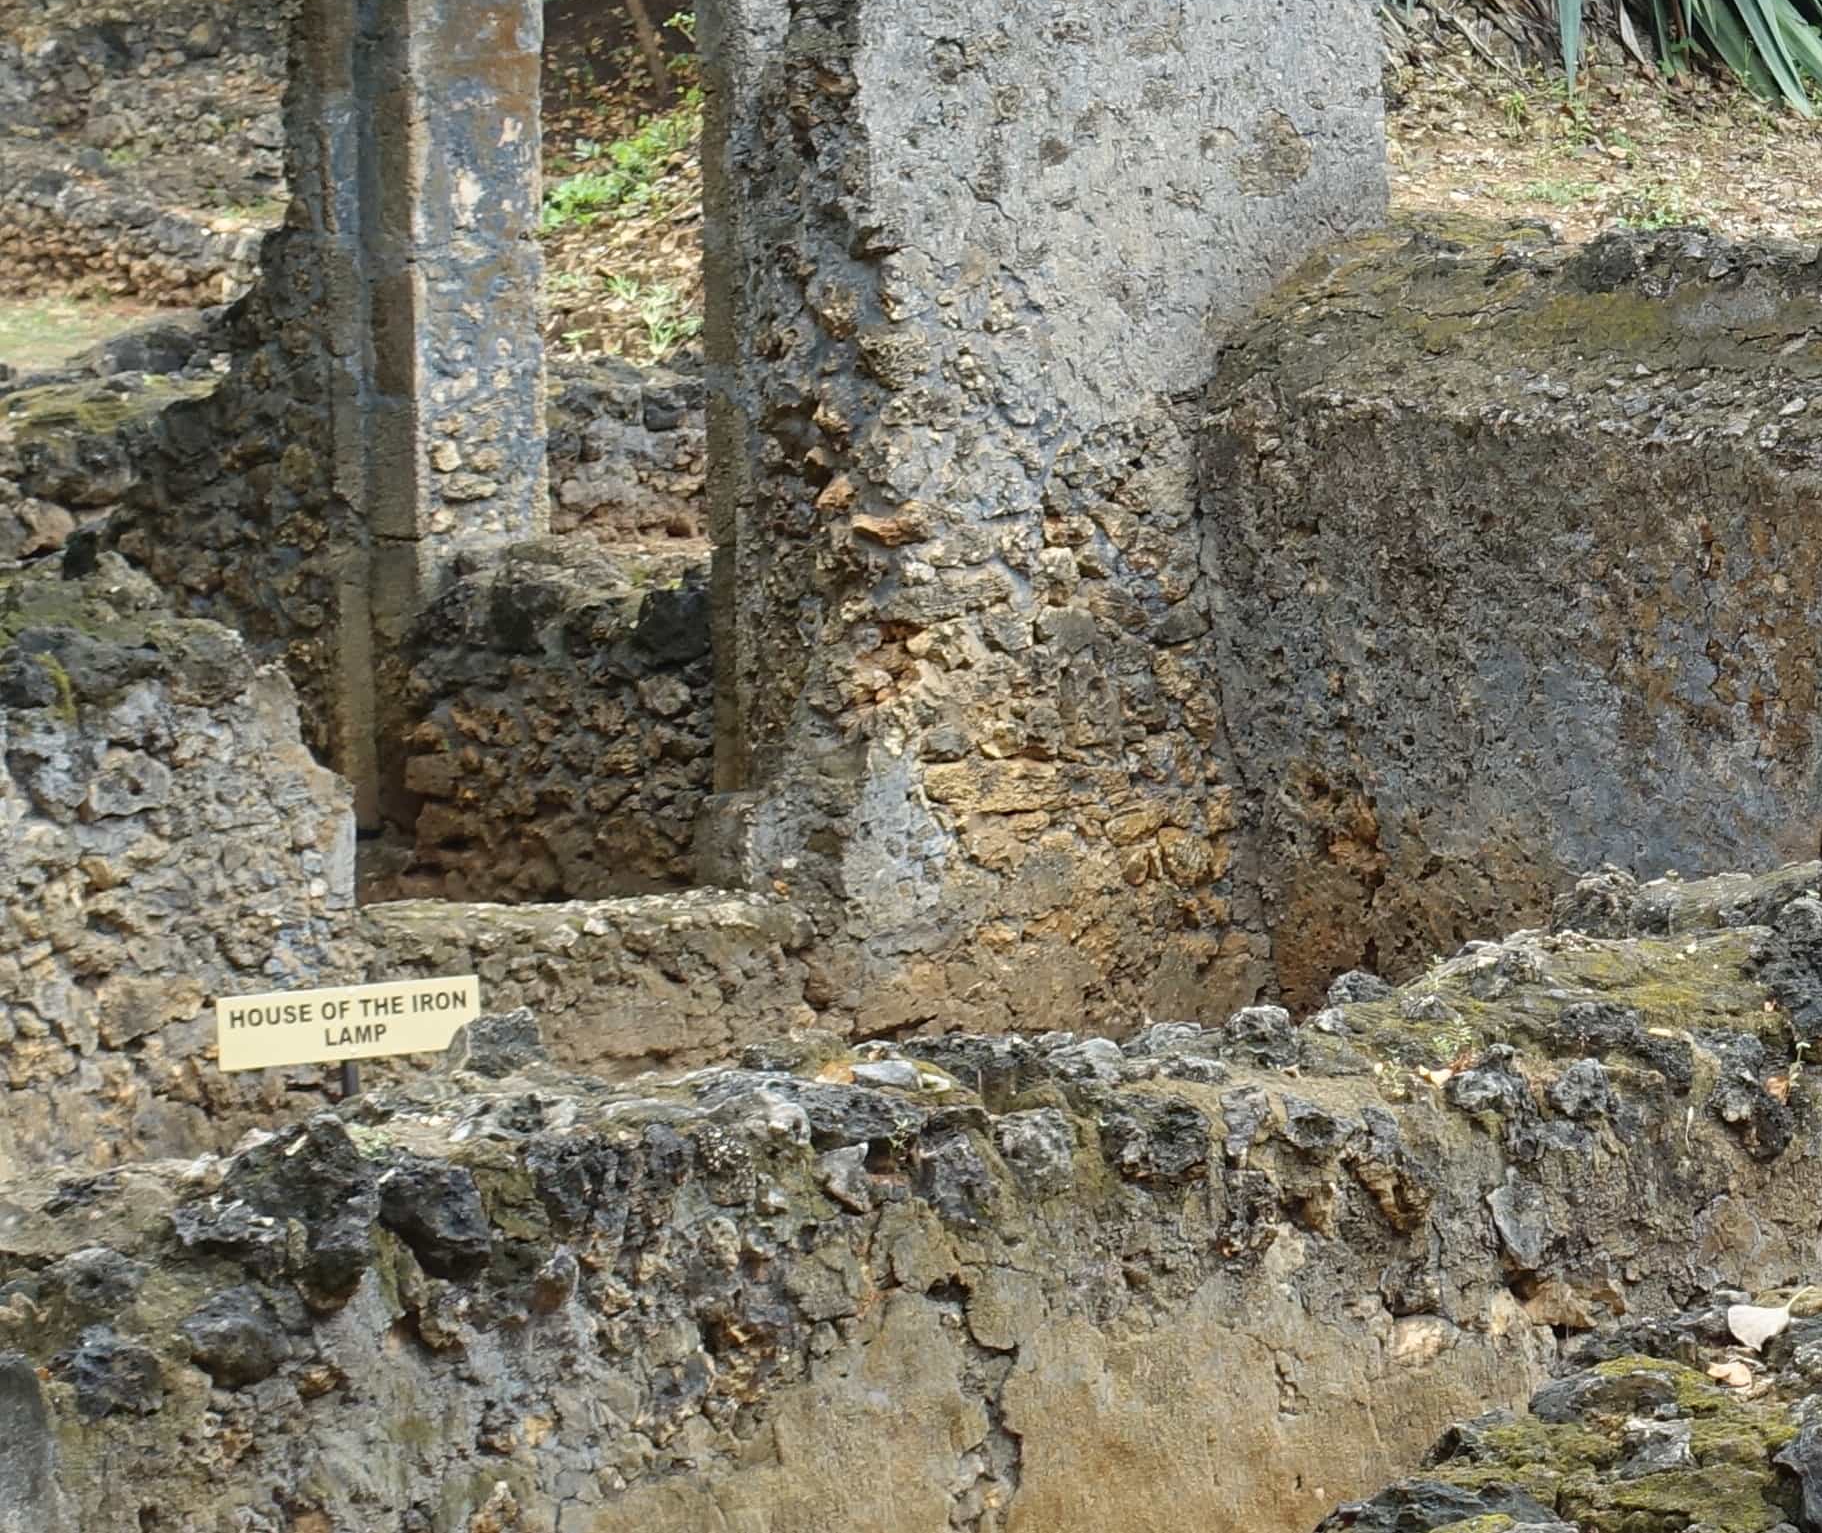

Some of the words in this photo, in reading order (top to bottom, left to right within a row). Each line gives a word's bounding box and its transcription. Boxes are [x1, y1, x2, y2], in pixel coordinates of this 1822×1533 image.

[229, 1003, 313, 1029] HOUSE
[321, 1000, 351, 1021] OF
[359, 995, 404, 1017] THE
[412, 990, 467, 1013] IRON
[325, 1023, 387, 1047] LAMP
